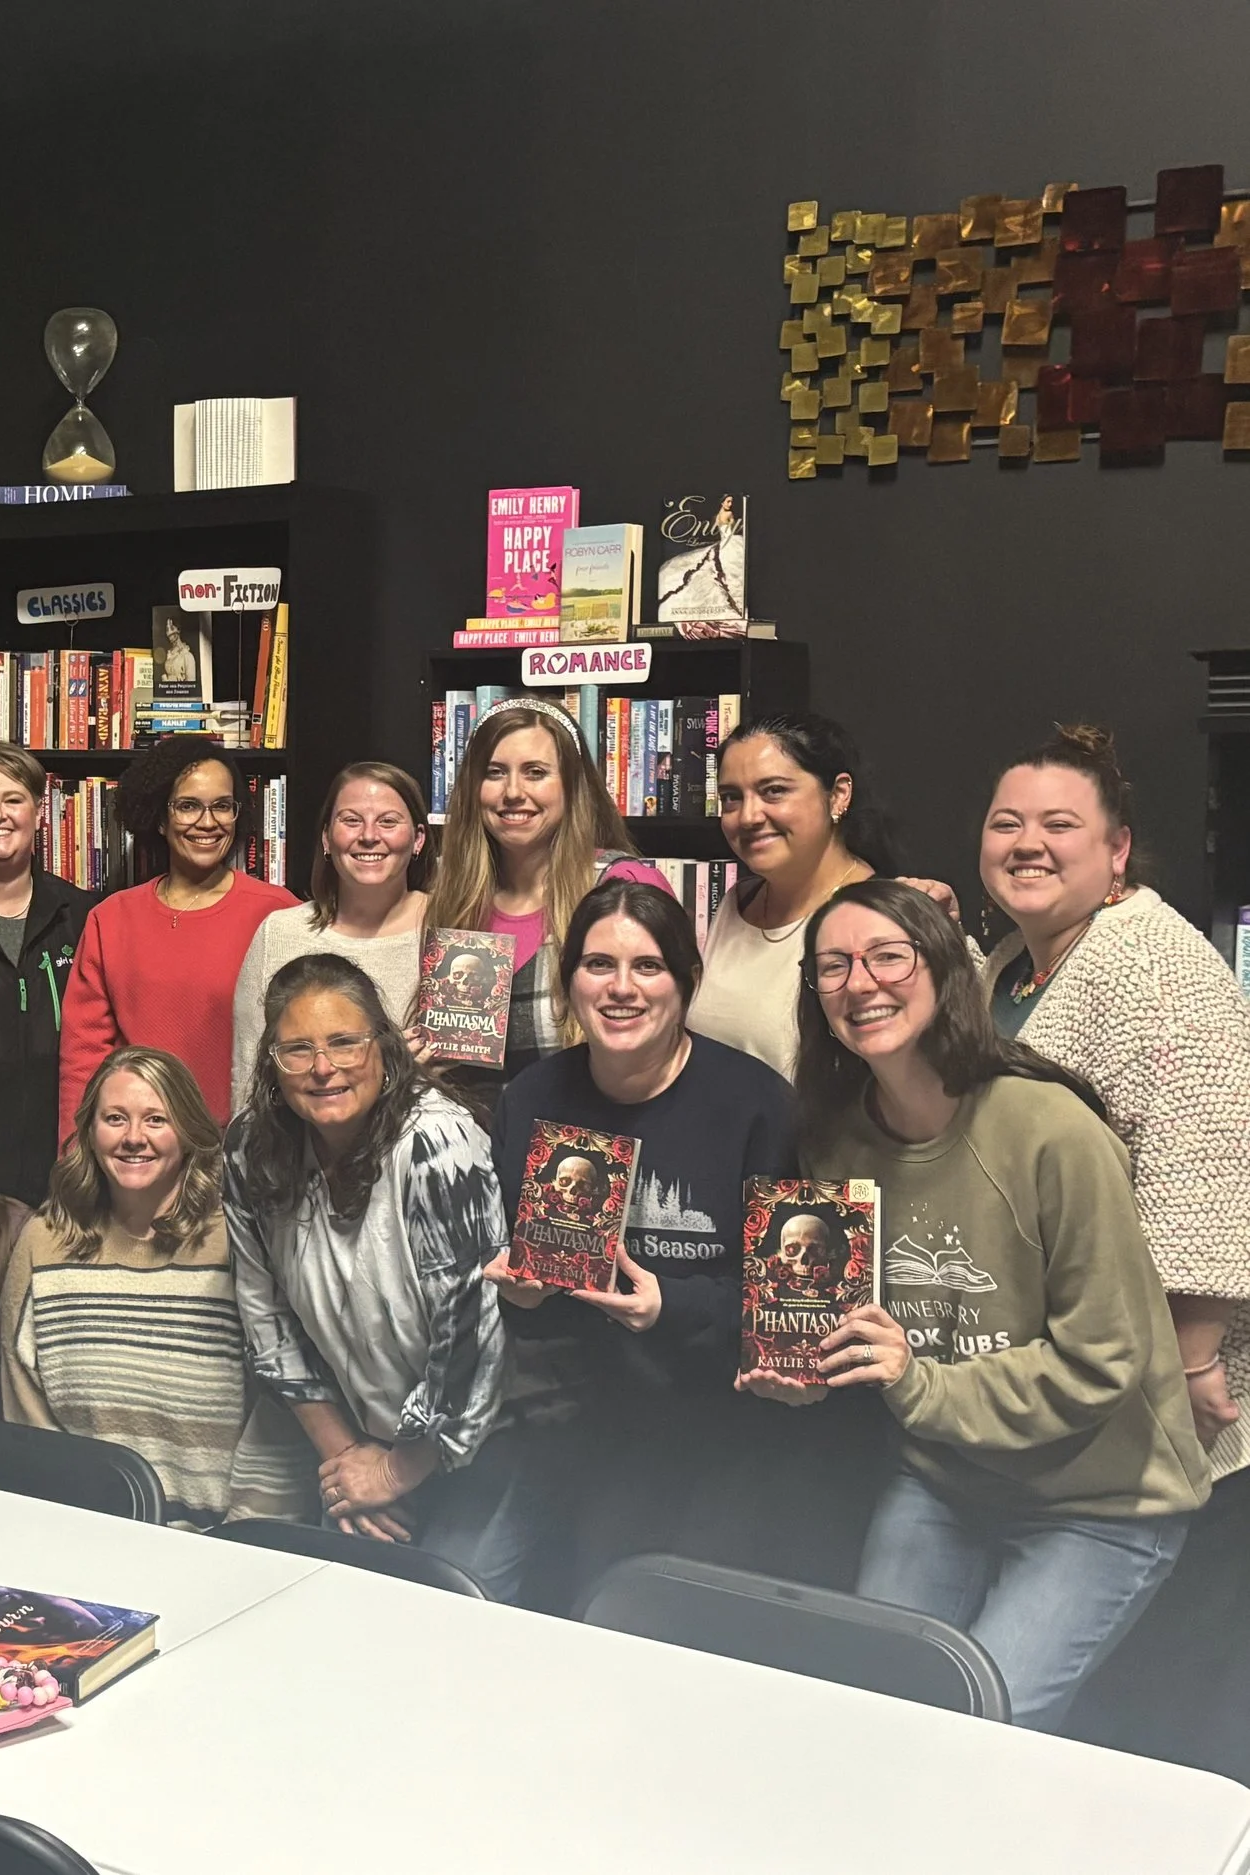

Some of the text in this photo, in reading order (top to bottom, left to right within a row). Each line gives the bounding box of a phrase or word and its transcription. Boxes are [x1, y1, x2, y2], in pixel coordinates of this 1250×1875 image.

[24, 485, 95, 504] HOME
[491, 496, 566, 516] EMILY HENRY
[503, 526, 552, 550] HAPPY
[596, 544, 622, 554] CARR
[504, 551, 550, 574] PLACE
[27, 591, 106, 617] CLASSICS
[459, 631, 559, 644] HAPPY PLACE EMILY HENR
[529, 649, 647, 675] ROMANCE
[98, 668, 109, 693] AYN
[69, 699, 77, 714] Life
[705, 711, 717, 735] PUNK
[706, 736, 717, 749] 57
[248, 836, 256, 869] CHINA
[56, 957, 68, 967] girl
[422, 1010, 504, 1038] PHANTASMA
[461, 1045, 491, 1054] SMITH
[521, 1220, 616, 1264] PHANTASMA
[644, 1234, 726, 1260] Season
[564, 1265, 598, 1283] SMITH
[752, 1308, 846, 1337] PHANTASM
[887, 1299, 981, 1325] WINEBRRY
[758, 1356, 804, 1369] KAYLIE
